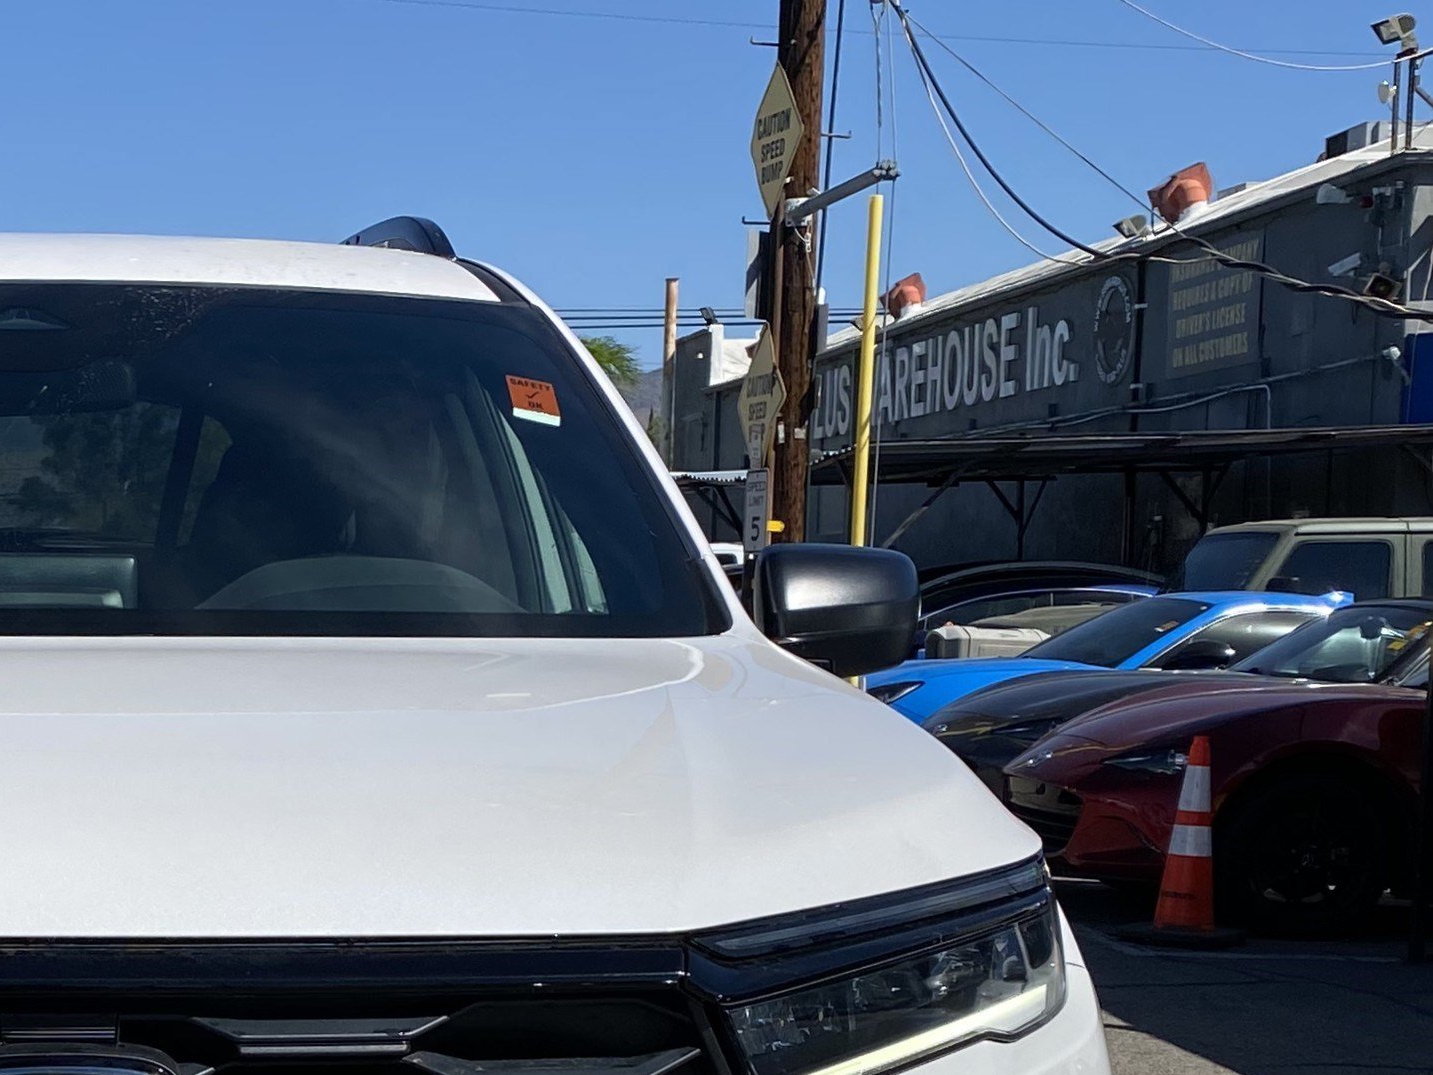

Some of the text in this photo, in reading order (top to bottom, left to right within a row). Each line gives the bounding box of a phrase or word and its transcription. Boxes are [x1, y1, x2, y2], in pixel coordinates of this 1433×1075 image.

[757, 107, 792, 140] CAUTION
[761, 138, 785, 163] SPEED
[761, 160, 784, 185] BUMP
[1212, 302, 1246, 330] LICENSE
[1026, 307, 1079, 391] Inc.
[510, 378, 550, 391] SAFETY
[528, 401, 544, 410] OK
[751, 516, 761, 542] 5
